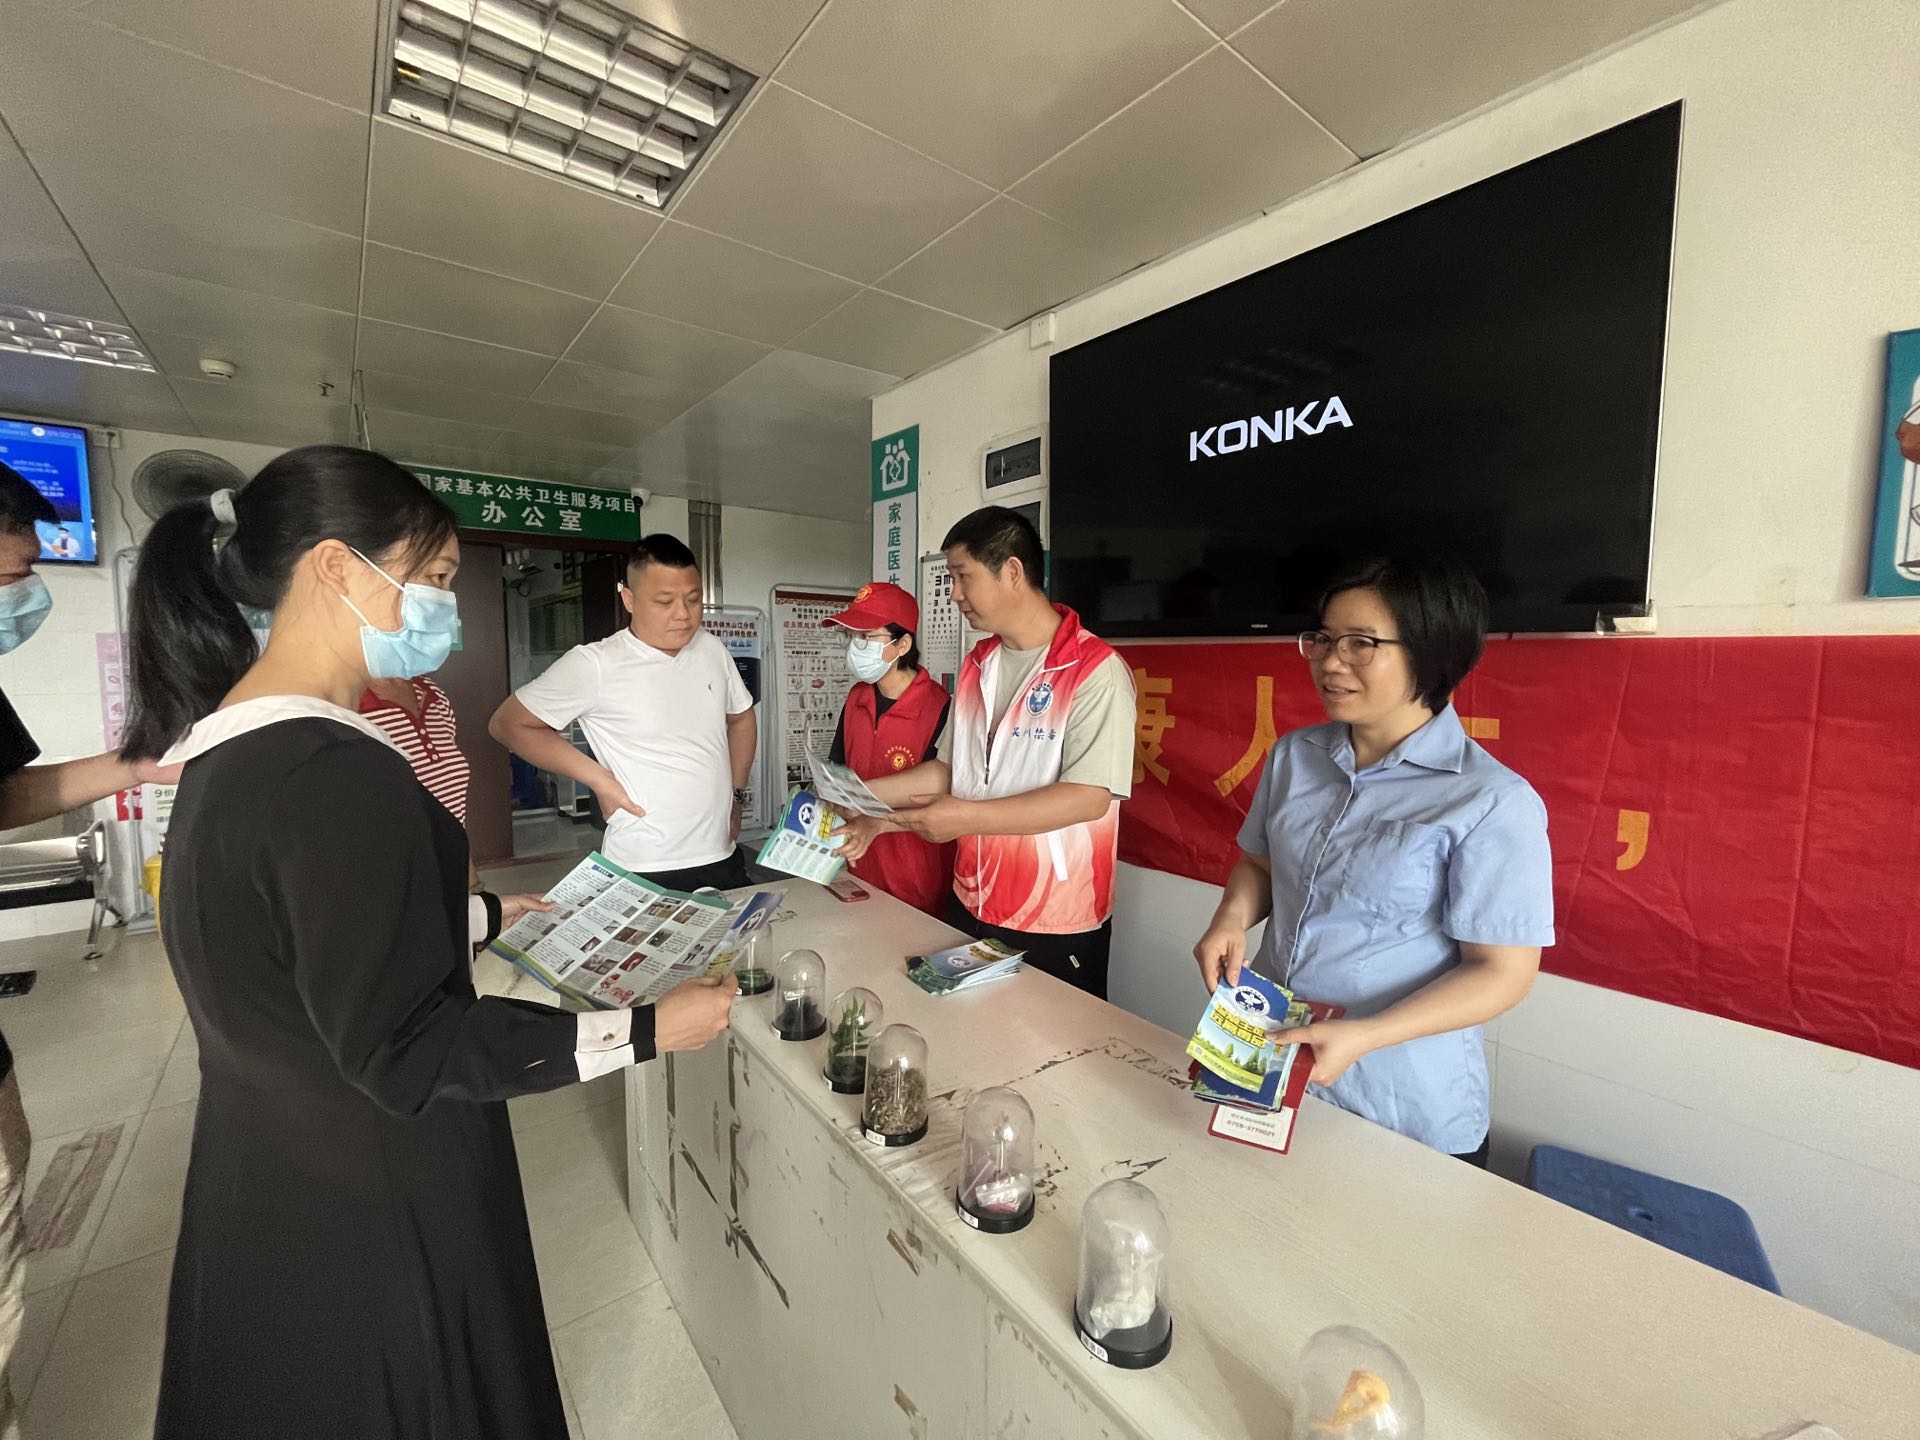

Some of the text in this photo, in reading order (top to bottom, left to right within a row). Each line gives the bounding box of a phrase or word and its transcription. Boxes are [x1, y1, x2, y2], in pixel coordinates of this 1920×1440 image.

[1190, 396, 1353, 461] KONKA
[414, 473, 636, 513] 国家基本公共卫生服务项目
[481, 501, 582, 531] 办公室
